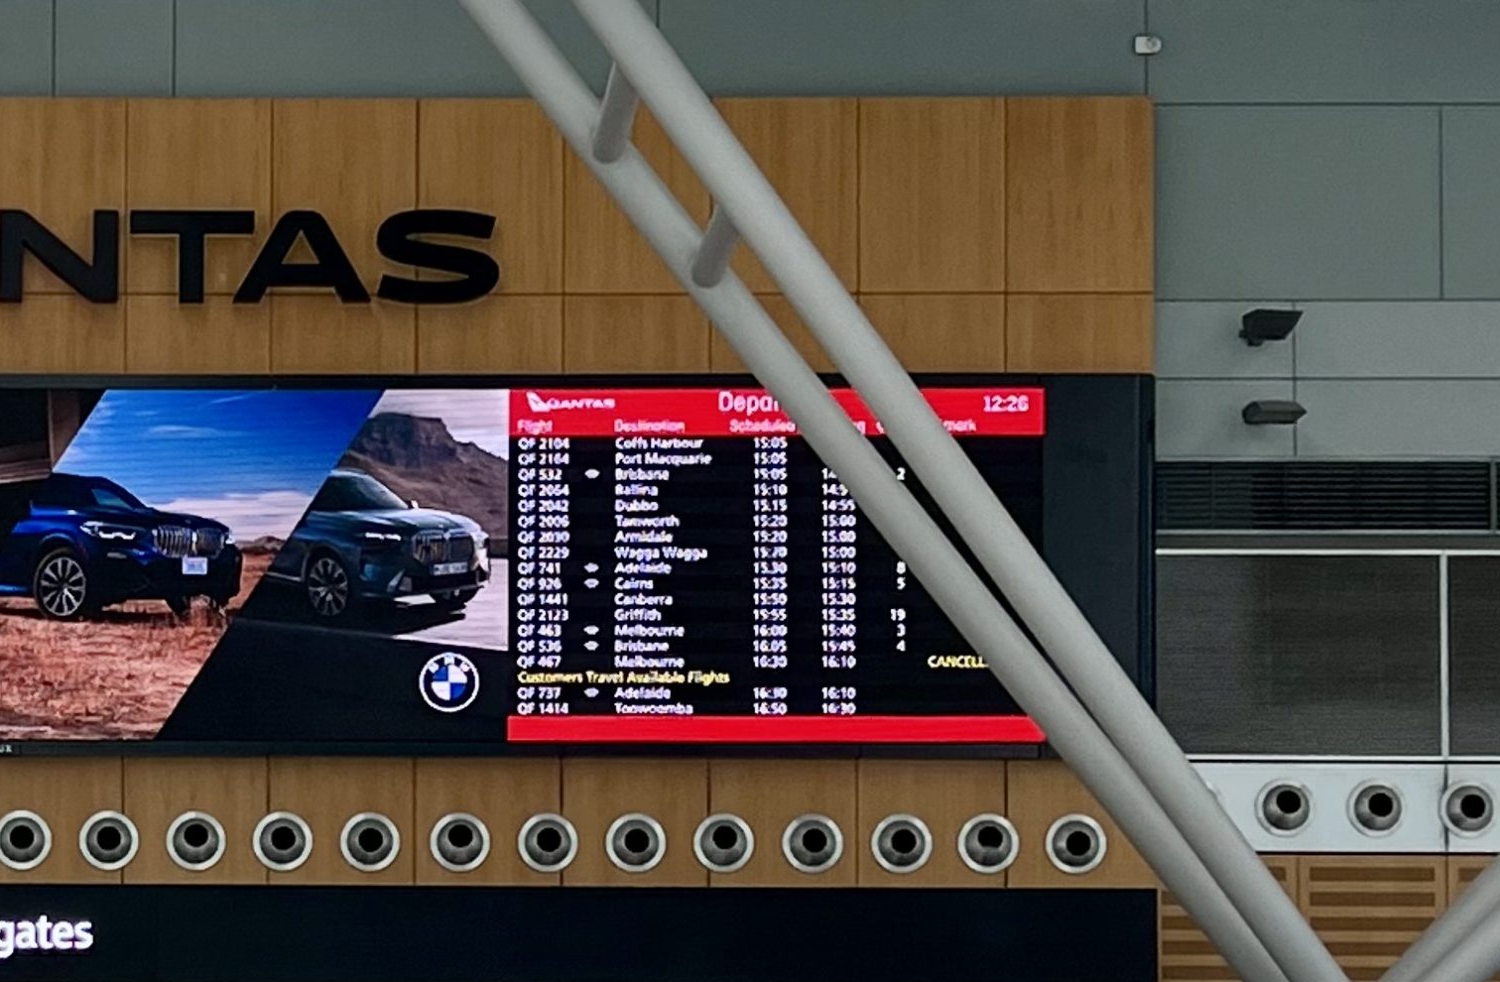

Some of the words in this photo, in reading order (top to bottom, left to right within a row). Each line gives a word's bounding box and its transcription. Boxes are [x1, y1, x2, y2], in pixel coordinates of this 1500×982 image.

[549, 398, 616, 409] QANTAS
[983, 395, 1030, 413] 12:26
[651, 437, 704, 449] Harbour
[615, 453, 642, 465] Port
[645, 453, 712, 467] Macquarie
[615, 468, 670, 481] Brisbane
[615, 499, 659, 512] Dubbo
[615, 514, 681, 527] Tamworth
[615, 530, 673, 543] Armidale
[614, 546, 660, 562] Wagga
[662, 546, 708, 562] Wagga
[614, 562, 672, 575] Adelaide
[614, 577, 654, 590] Cairns
[614, 593, 673, 606] Canberra
[614, 625, 685, 637] Melbourne
[614, 640, 670, 653] Brisbane
[614, 655, 685, 668] Melbourne
[927, 655, 988, 668] CANCELL
[517, 672, 583, 684] Customers
[586, 671, 624, 684] Travel
[627, 671, 685, 684] Available
[687, 671, 730, 686] Flights
[614, 687, 671, 699] Adelaide
